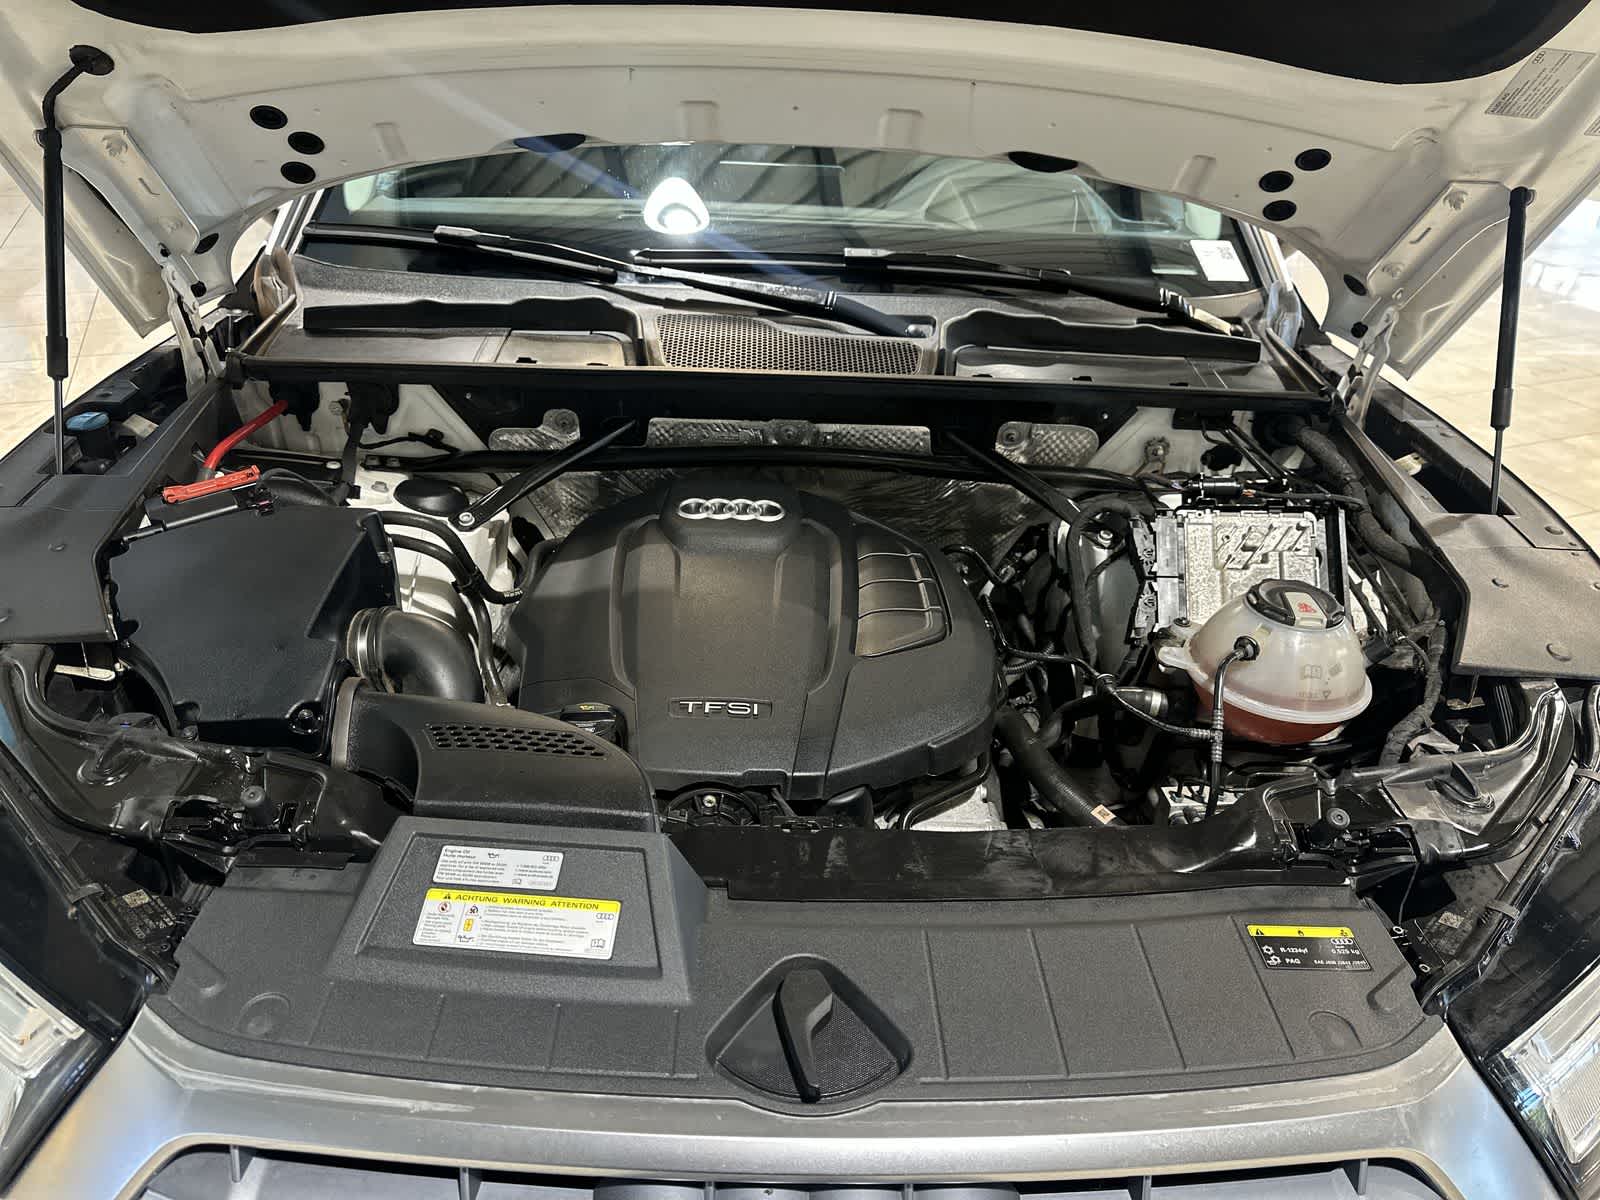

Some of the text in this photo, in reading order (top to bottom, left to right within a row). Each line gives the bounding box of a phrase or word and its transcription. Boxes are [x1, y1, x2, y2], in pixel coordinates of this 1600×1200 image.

[679, 701, 758, 715] TFSI
[455, 893, 600, 910] ACHTUNG WARNING ATTENTION
